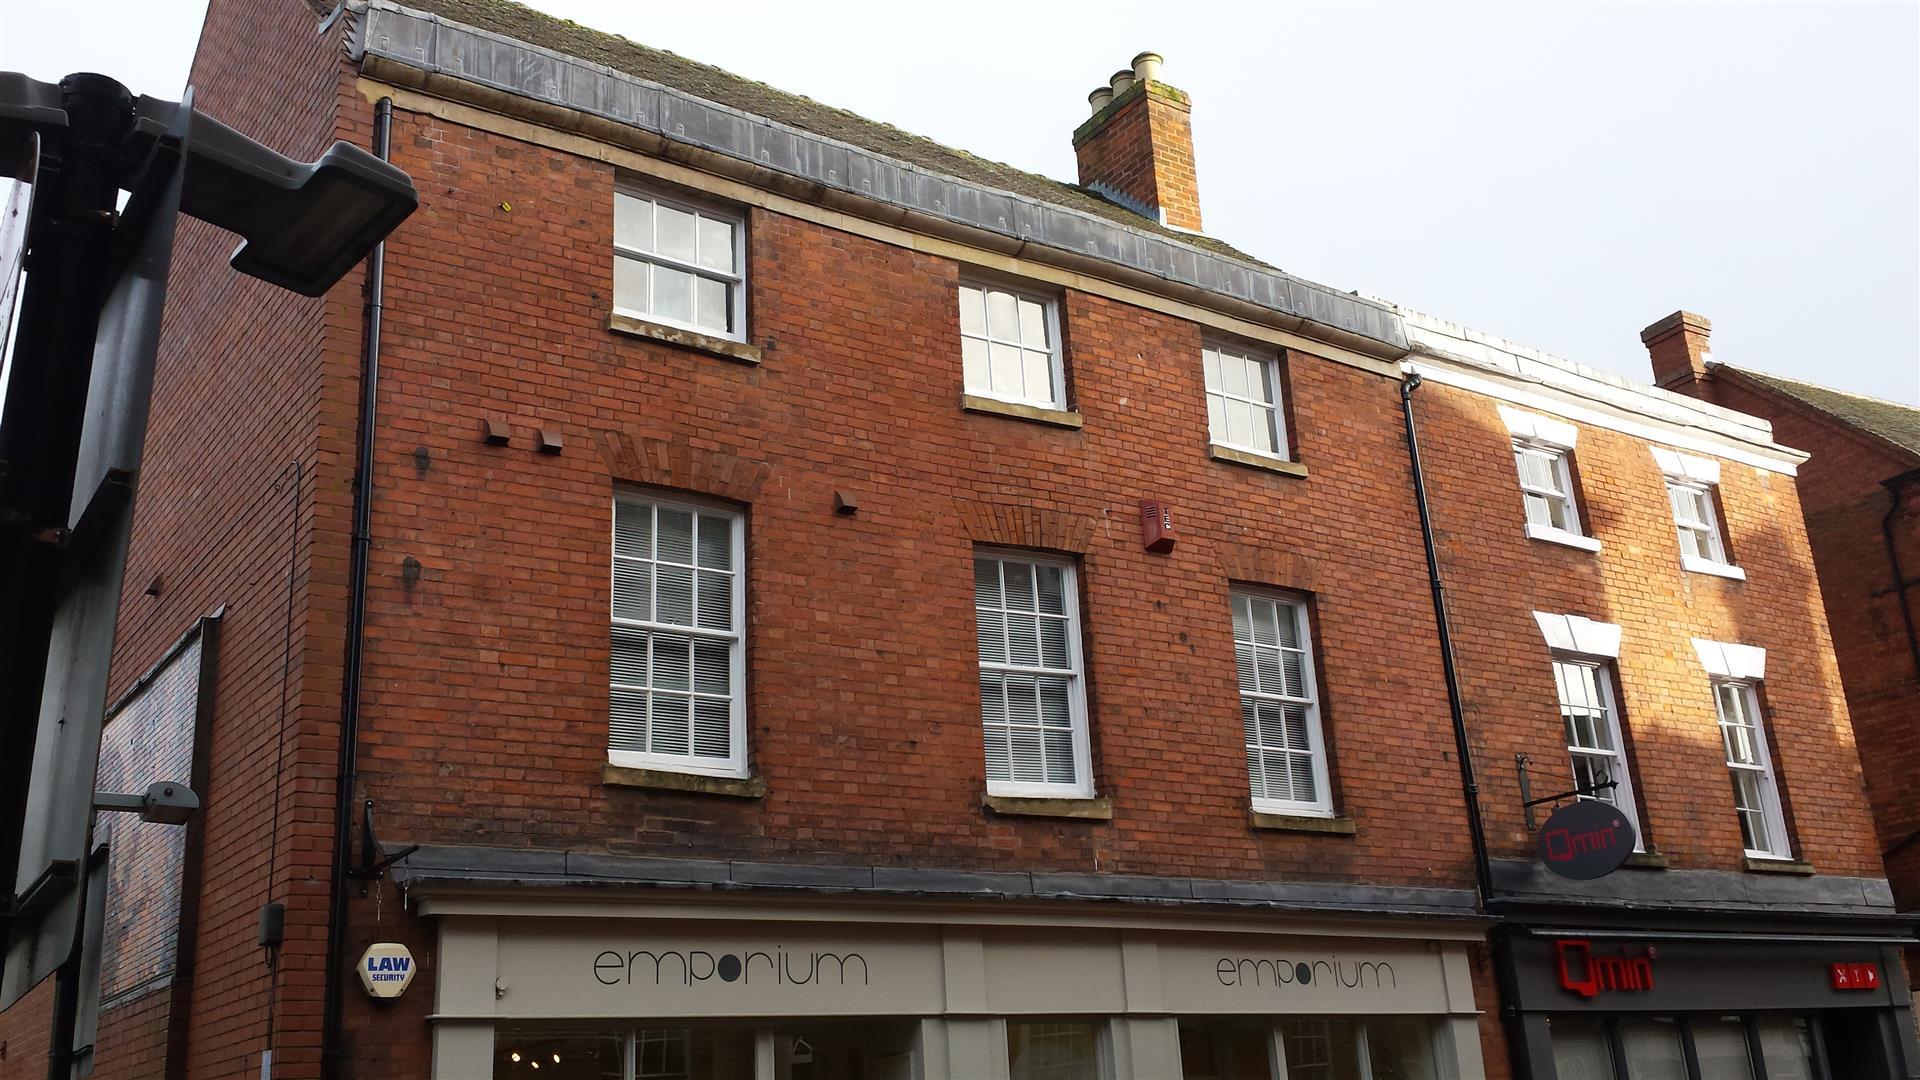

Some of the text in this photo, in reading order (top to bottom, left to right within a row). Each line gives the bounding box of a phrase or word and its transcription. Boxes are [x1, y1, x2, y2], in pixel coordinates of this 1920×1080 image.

[1544, 824, 1617, 861] Qmin
[367, 957, 411, 972] LAW
[372, 973, 405, 982] SECURITY
[593, 944, 868, 987] emporium
[1216, 955, 1396, 988] emporium
[1557, 940, 1654, 996] Qmin
